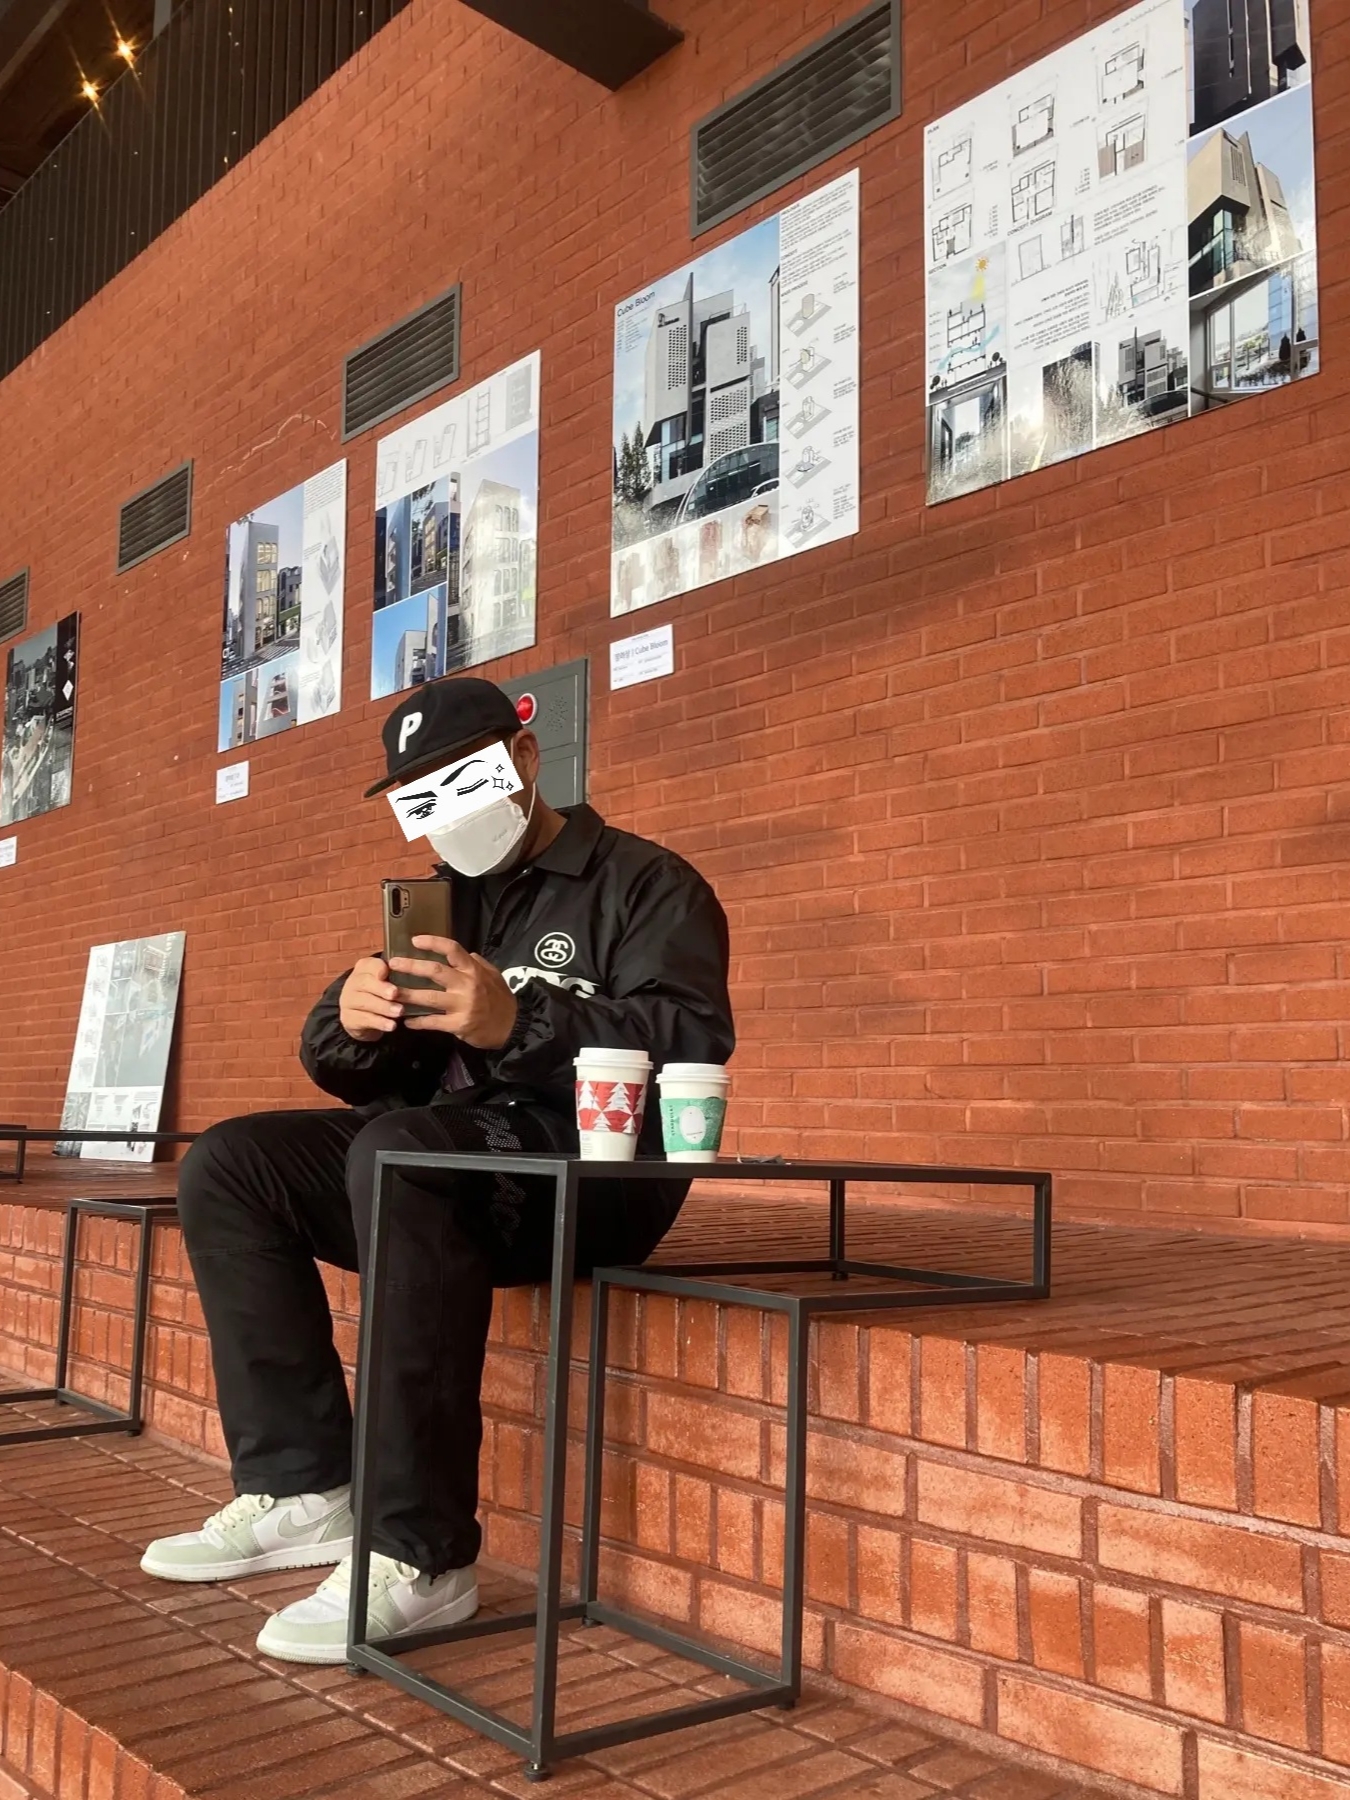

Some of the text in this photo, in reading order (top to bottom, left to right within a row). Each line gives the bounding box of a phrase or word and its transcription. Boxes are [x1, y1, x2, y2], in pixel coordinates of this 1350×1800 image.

[617, 292, 655, 317] Cube Bloom
[635, 645, 649, 655] Cube
[650, 640, 668, 650] Bloom
[398, 711, 423, 754] P
